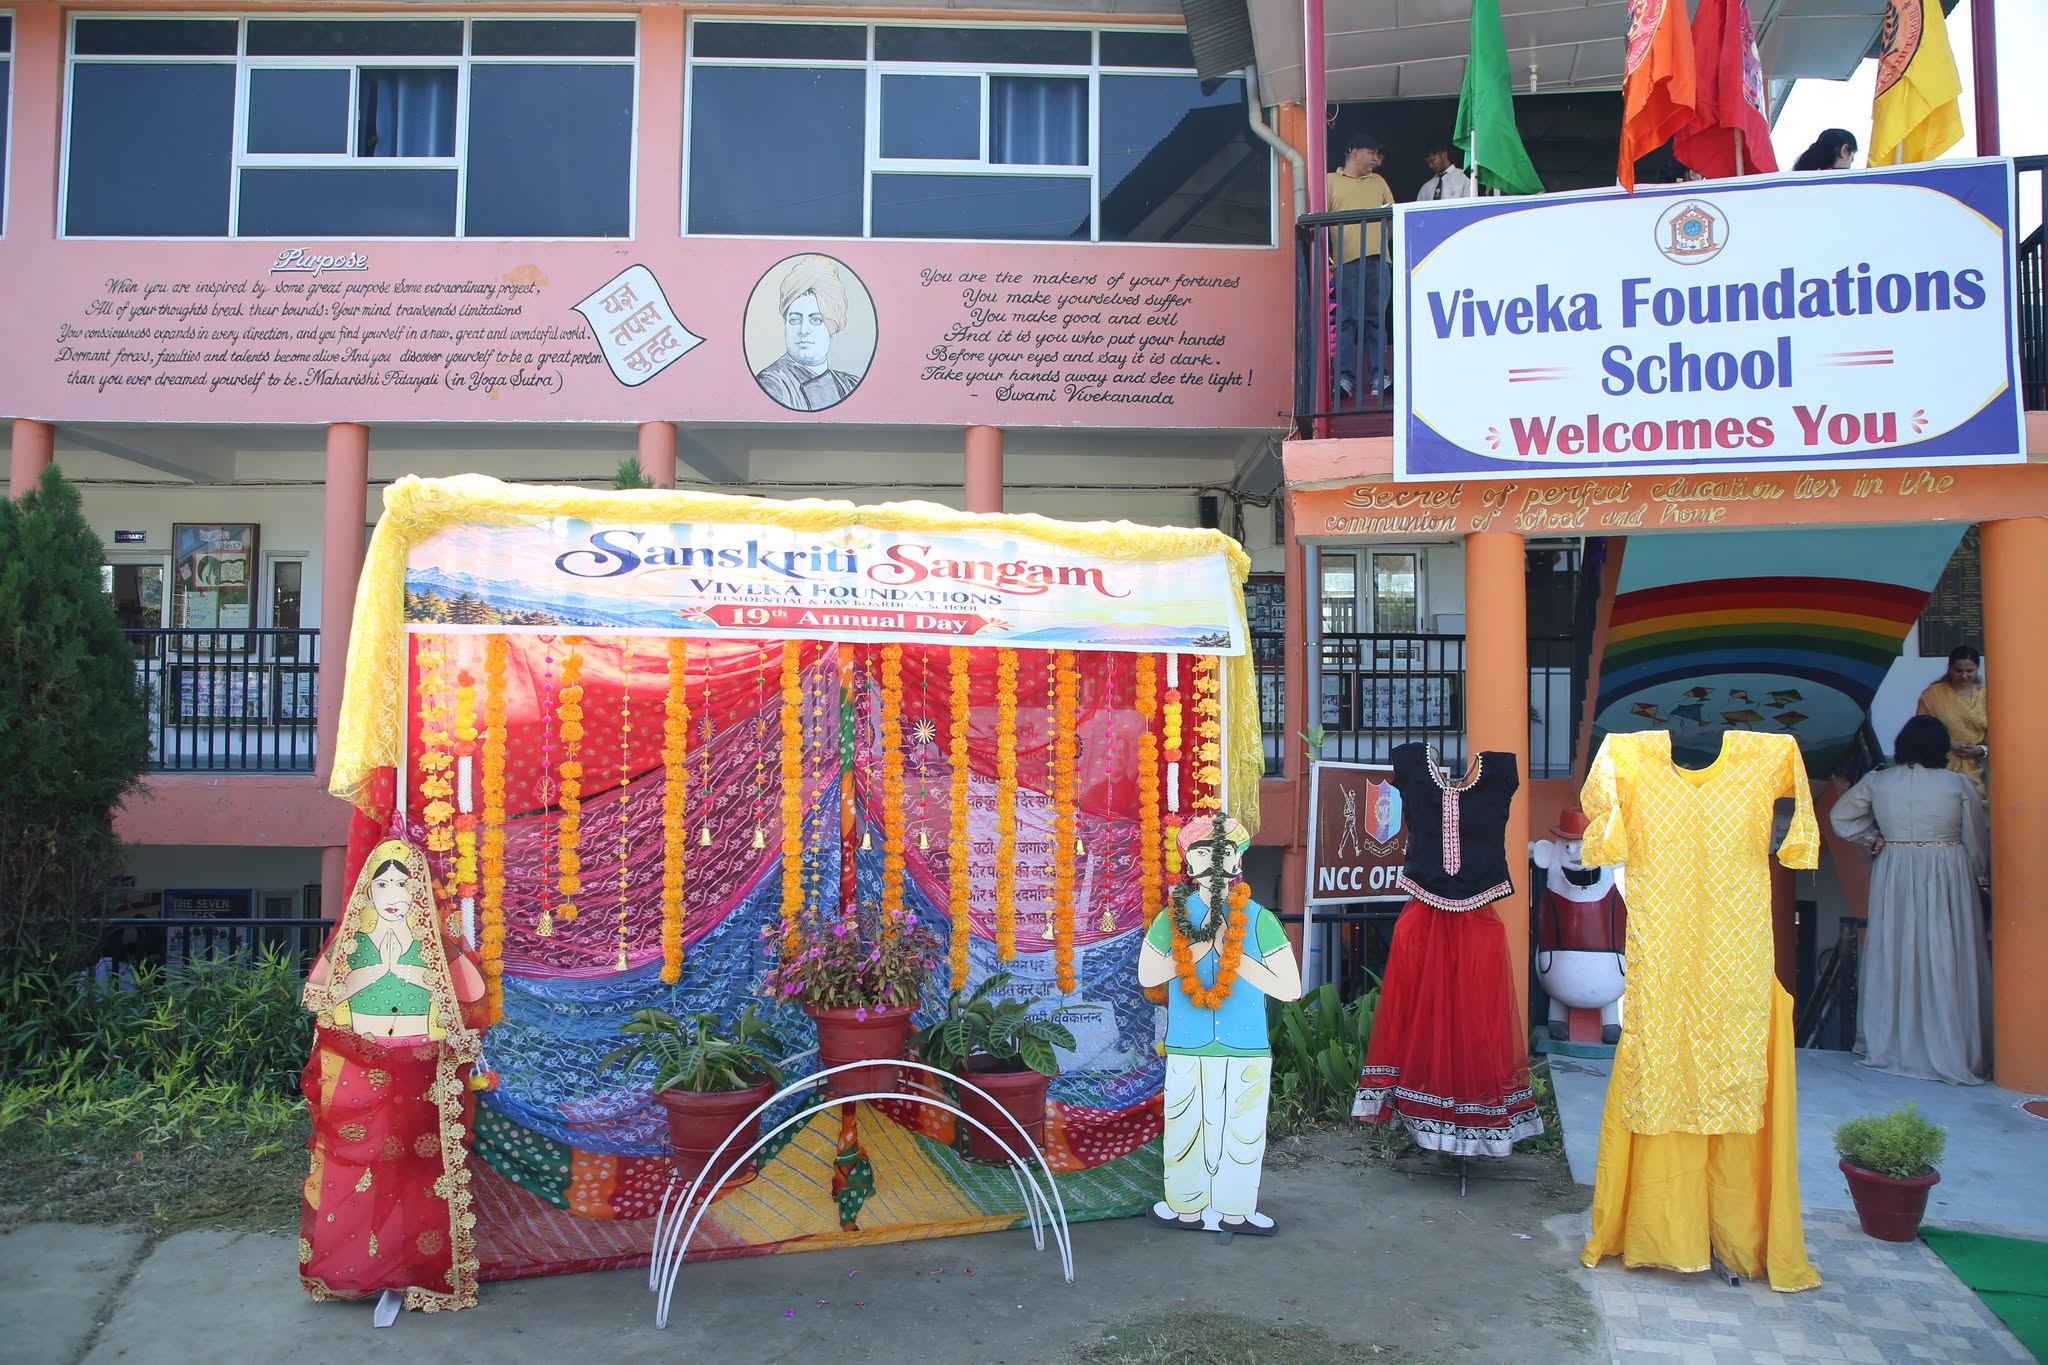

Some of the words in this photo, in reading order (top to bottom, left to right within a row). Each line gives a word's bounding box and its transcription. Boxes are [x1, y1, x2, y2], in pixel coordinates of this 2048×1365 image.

[270, 247, 369, 277] Purpose
[104, 278, 138, 294] When
[143, 284, 169, 300] you
[172, 284, 191, 293] are
[195, 280, 247, 298] inspired
[251, 280, 270, 299] by
[307, 281, 342, 301] great
[343, 283, 391, 298] purpose
[424, 281, 496, 299] extraordinary
[920, 267, 953, 288] You
[958, 273, 987, 284] are
[995, 271, 1023, 284] the
[1032, 271, 1098, 285] makers
[1106, 272, 1126, 291] of
[1129, 276, 1171, 292] your
[1169, 273, 1241, 292] fortunes
[85, 299, 112, 316] All
[116, 301, 130, 321] of
[130, 306, 157, 322] your
[158, 303, 208, 322] thoughts
[211, 302, 244, 316] break
[249, 303, 279, 316] their
[332, 301, 361, 321] Your
[362, 303, 391, 316] mind
[396, 303, 457, 317] transcends
[962, 288, 998, 309] You
[1006, 290, 1052, 305] make
[1057, 292, 1141, 310] yourselves
[1143, 293, 1193, 313] suffer
[1427, 283, 1602, 339] Viveka
[1621, 262, 1986, 328] Foundations
[970, 307, 1007, 328] You
[1012, 310, 1058, 324] make
[1062, 311, 1102, 329] good
[1108, 312, 1142, 325] and
[1146, 312, 1179, 326] evil
[84, 327, 151, 339] consciousness
[153, 325, 196, 343] expands
[196, 325, 209, 339] in
[211, 328, 240, 345] every
[296, 326, 317, 339] and
[318, 330, 336, 344] you
[337, 326, 361, 345] find
[361, 325, 405, 345] yourself
[405, 326, 418, 339] in
[455, 327, 485, 345] great
[486, 326, 507, 339] and
[510, 325, 558, 345] wonderful
[943, 322, 992, 342] And
[996, 329, 1013, 343] it
[1016, 330, 1032, 343] is
[1035, 333, 1068, 349] you
[1071, 331, 1105, 344] who
[1106, 332, 1136, 348] put
[1138, 335, 1175, 351] your
[1178, 331, 1226, 346] hands
[55, 347, 111, 362] Dormant
[152, 348, 201, 368] faculties
[203, 349, 227, 362] and
[230, 349, 270, 362] talents
[273, 350, 310, 363] become
[312, 350, 340, 362] alive
[341, 347, 371, 363] And
[371, 353, 392, 368] you
[399, 349, 443, 363] discover
[445, 348, 497, 369] yourself
[496, 350, 509, 363] to
[509, 350, 522, 363] be
[524, 353, 533, 363] a
[538, 350, 570, 370] great
[570, 352, 602, 367] person
[925, 344, 985, 367] Before
[988, 352, 1024, 367] your
[1027, 351, 1059, 367] eyes
[1062, 351, 1094, 363] and
[1131, 352, 1145, 364] it
[1149, 352, 1166, 365] is
[1601, 336, 1793, 396] School
[67, 370, 96, 385] than
[98, 374, 124, 394] you
[126, 375, 152, 385] ever
[154, 371, 208, 386] dreamed
[209, 372, 266, 393] yourself
[268, 372, 281, 386] to
[468, 369, 506, 393] Yoga
[920, 365, 964, 381] Take
[965, 371, 1004, 386] your
[1008, 368, 1061, 383] hands
[1064, 372, 1108, 388] away
[1112, 371, 1146, 384] and
[1179, 372, 1204, 386] the
[995, 383, 1057, 403] Swami
[1063, 383, 1175, 405] Vivekananda
[1509, 408, 1775, 456] Welcomes
[1792, 403, 1897, 447] You
[1343, 482, 1464, 510] Secret
[1481, 484, 1519, 507] of
[1520, 479, 1633, 512] perfect
[1650, 476, 1785, 502] education
[1852, 472, 1884, 498] in
[1898, 469, 1955, 497] the
[1325, 511, 1457, 535] communion
[1470, 508, 1501, 532] of
[1513, 505, 1590, 531] school
[1600, 502, 1648, 528] and
[1659, 504, 1727, 526] home
[554, 530, 860, 581] Sanskriti
[866, 543, 1132, 599] Sangam
[689, 578, 804, 596] VIVEKA
[812, 583, 1003, 606] FOUNDATIONS
[730, 607, 788, 625] 19th
[797, 609, 905, 629] Annual
[911, 614, 968, 634] Day
[1318, 865, 1364, 892] NCC
[197, 898, 230, 909] SEVEN
